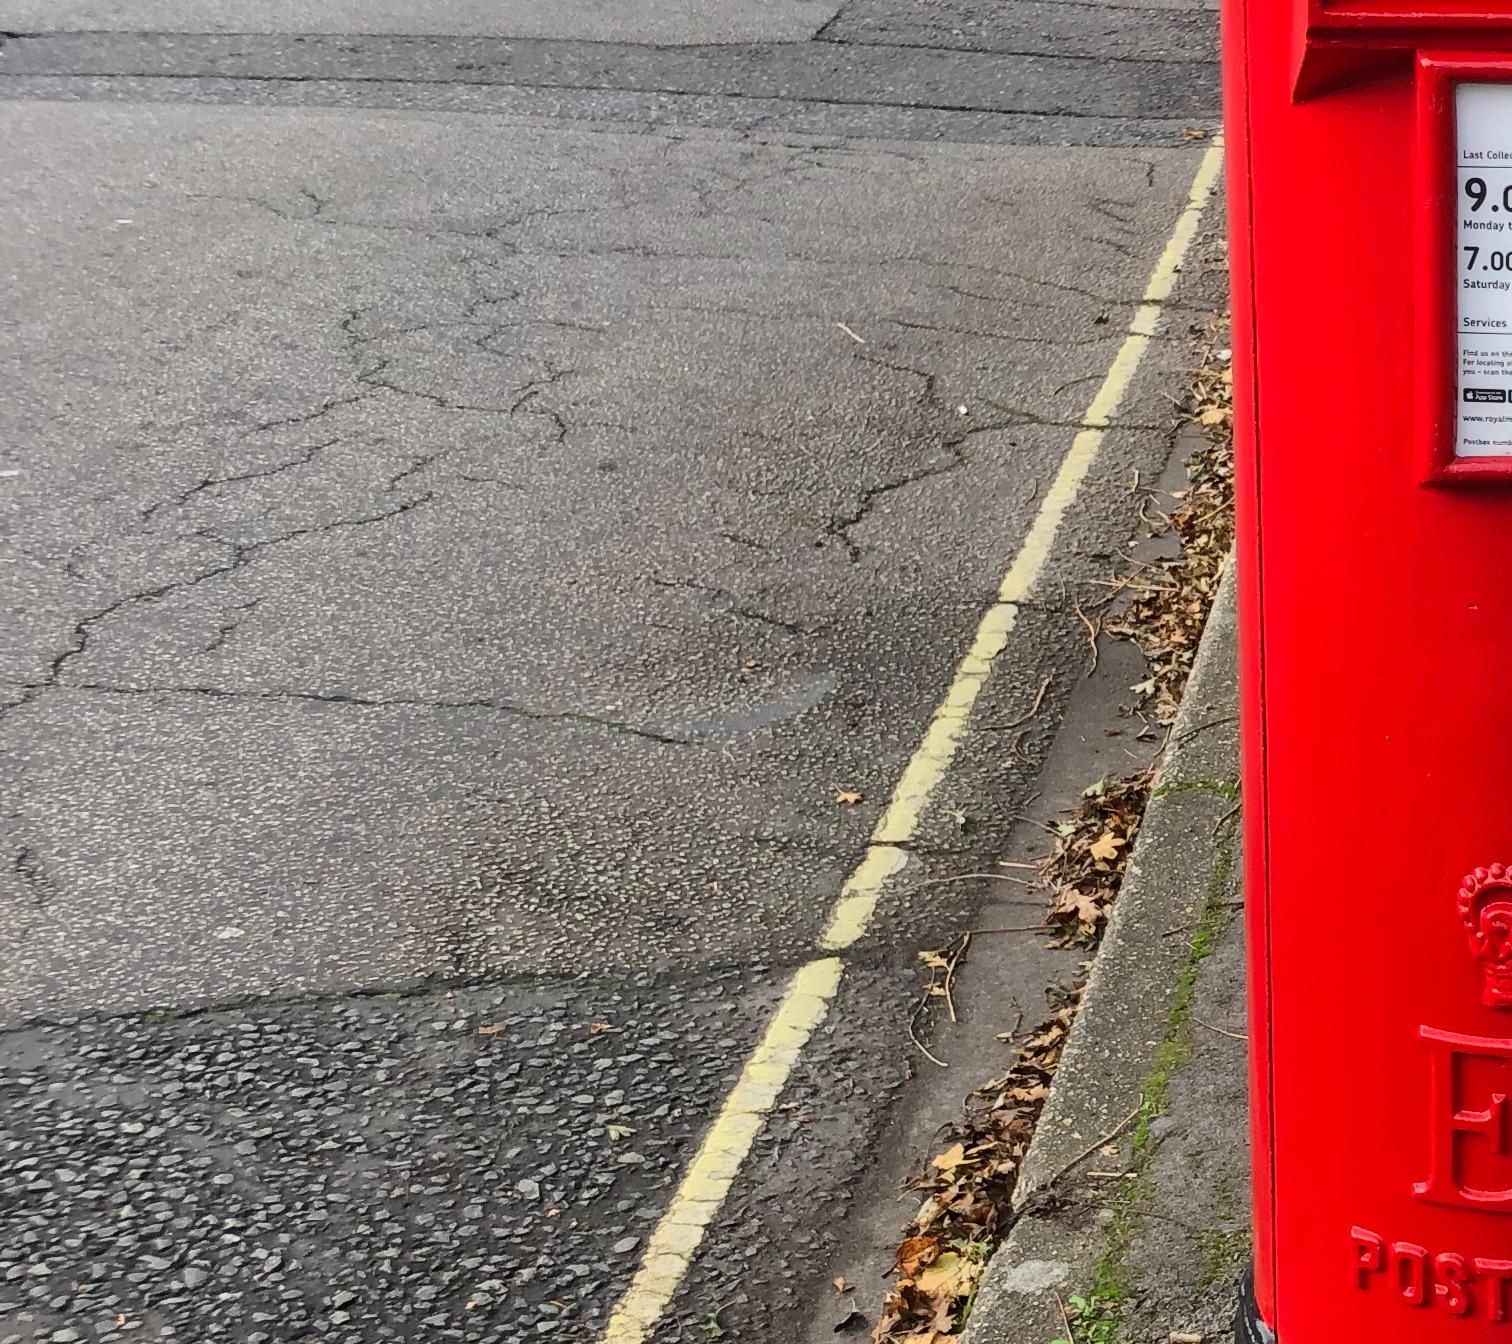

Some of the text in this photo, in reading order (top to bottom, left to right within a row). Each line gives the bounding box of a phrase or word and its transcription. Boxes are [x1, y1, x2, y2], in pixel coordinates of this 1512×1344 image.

[1463, 150, 1484, 160] Last
[1463, 219, 1505, 233] Monday
[1463, 278, 1511, 291] Saturday
[1463, 316, 1508, 328] Services
[1462, 358, 1475, 366] For
[1476, 359, 1505, 367] locating
[1463, 438, 1491, 446] Postbox
